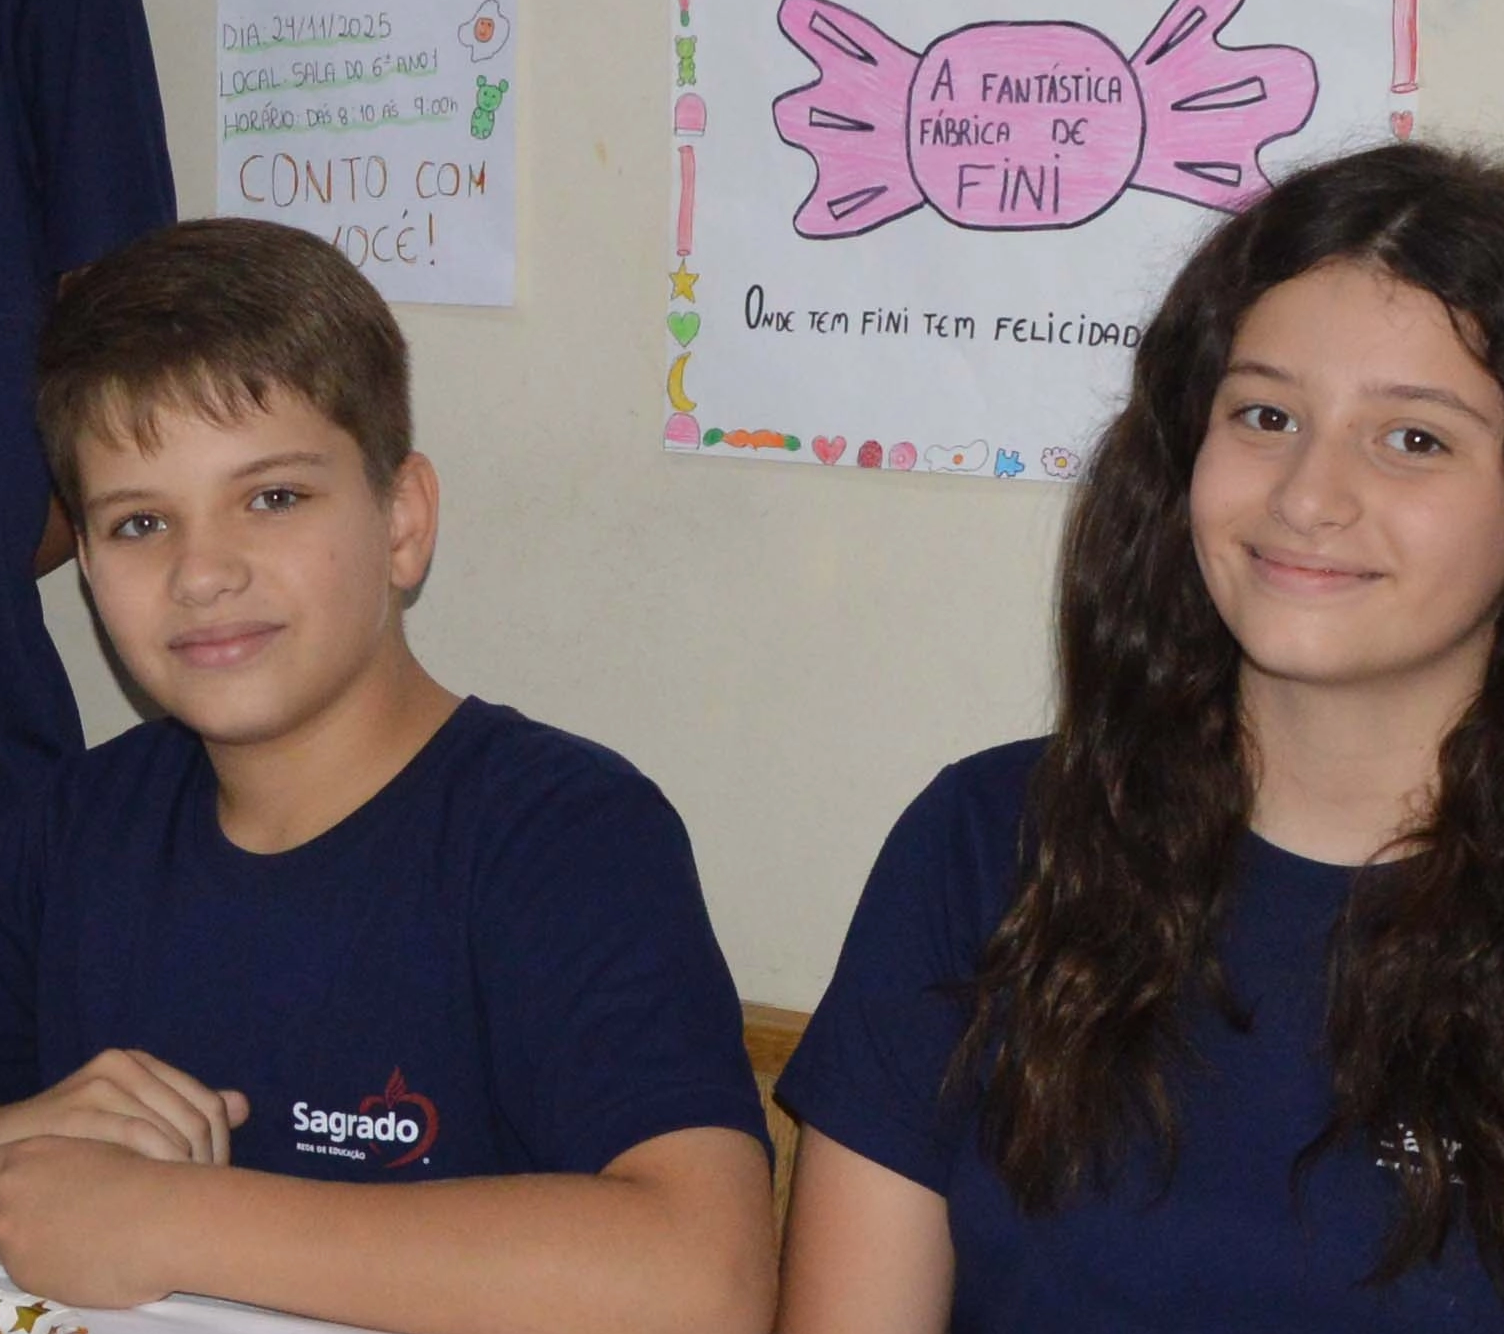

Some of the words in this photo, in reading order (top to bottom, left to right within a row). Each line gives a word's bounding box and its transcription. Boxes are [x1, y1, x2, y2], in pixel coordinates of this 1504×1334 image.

[292, 60, 336, 88] SALA
[345, 59, 364, 80] DO
[930, 57, 955, 102] A
[1051, 117, 1090, 146] DE
[239, 152, 388, 208] CONTO
[415, 159, 487, 199] COM
[292, 1101, 420, 1143] Sagrado
